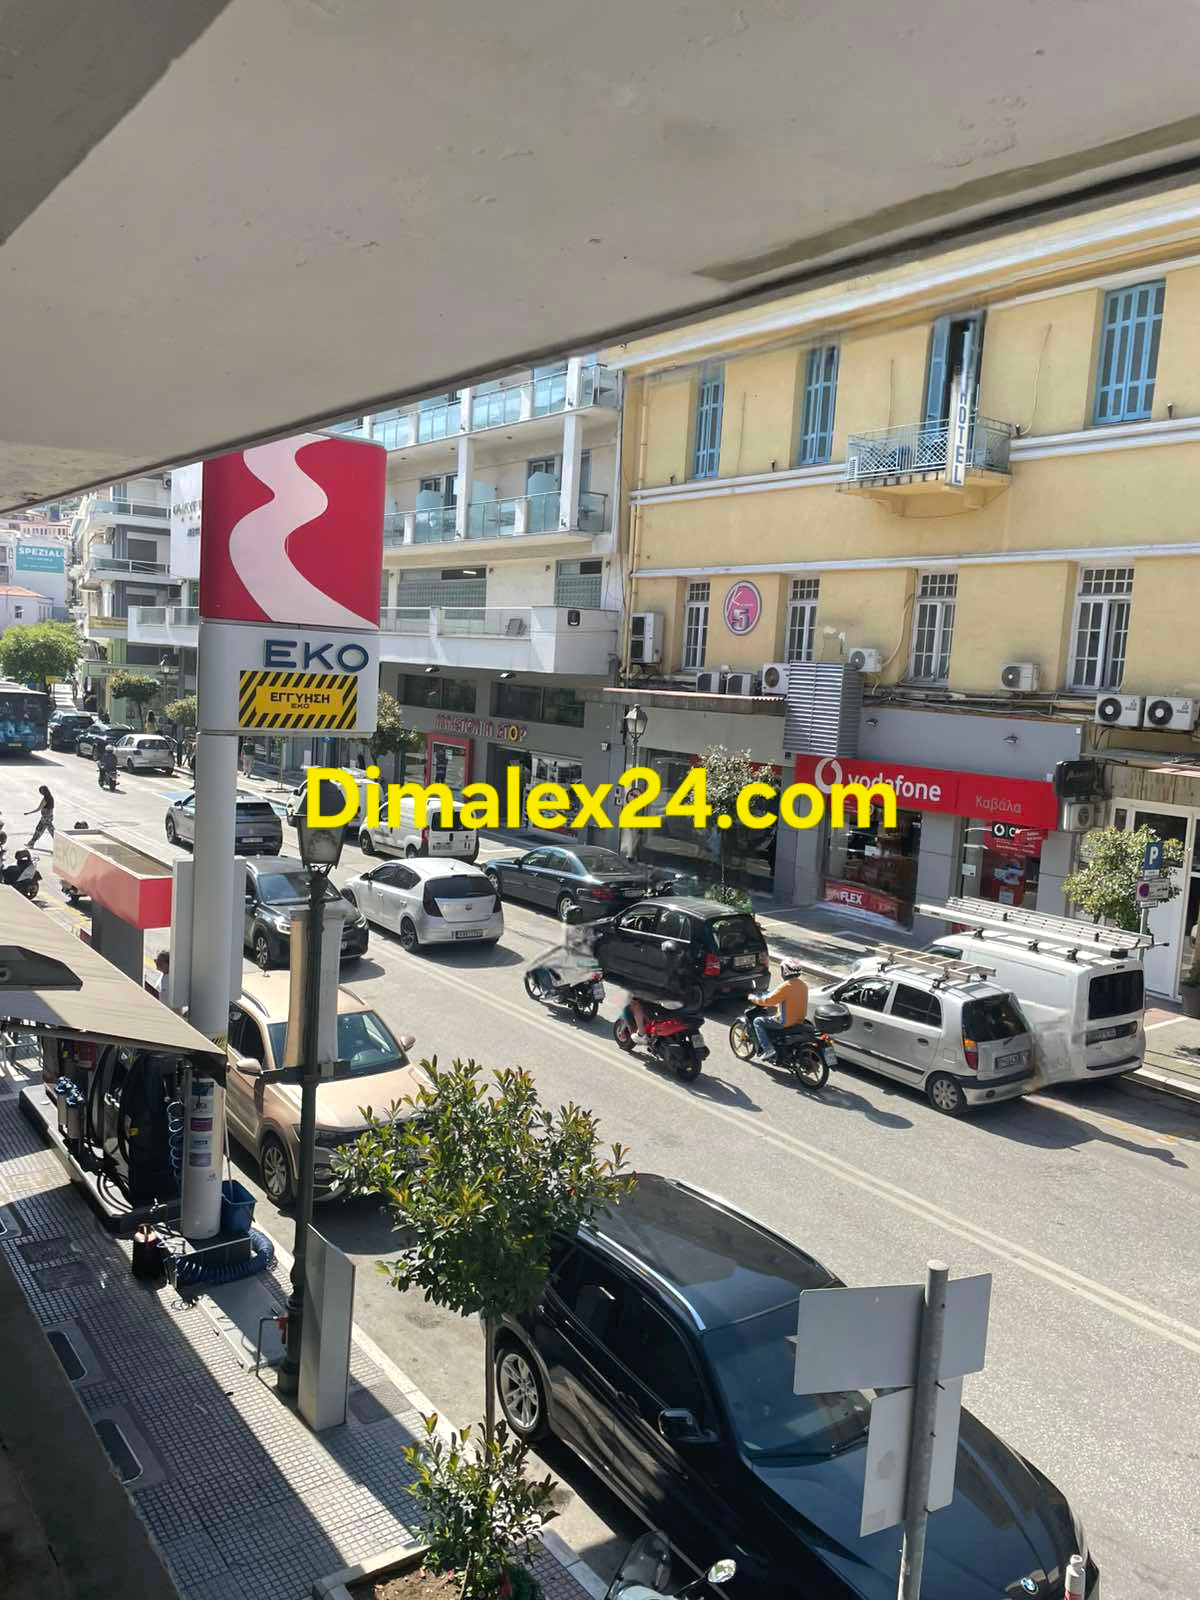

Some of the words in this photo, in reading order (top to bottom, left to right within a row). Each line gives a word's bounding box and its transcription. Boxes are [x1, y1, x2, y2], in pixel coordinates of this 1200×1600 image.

[954, 392, 967, 484] HOTEL
[264, 639, 368, 672] EKO
[270, 692, 330, 704] ΕΓΓΥΗΣΗ
[975, 794, 1022, 814] Καβάλα
[1149, 846, 1159, 865] P
